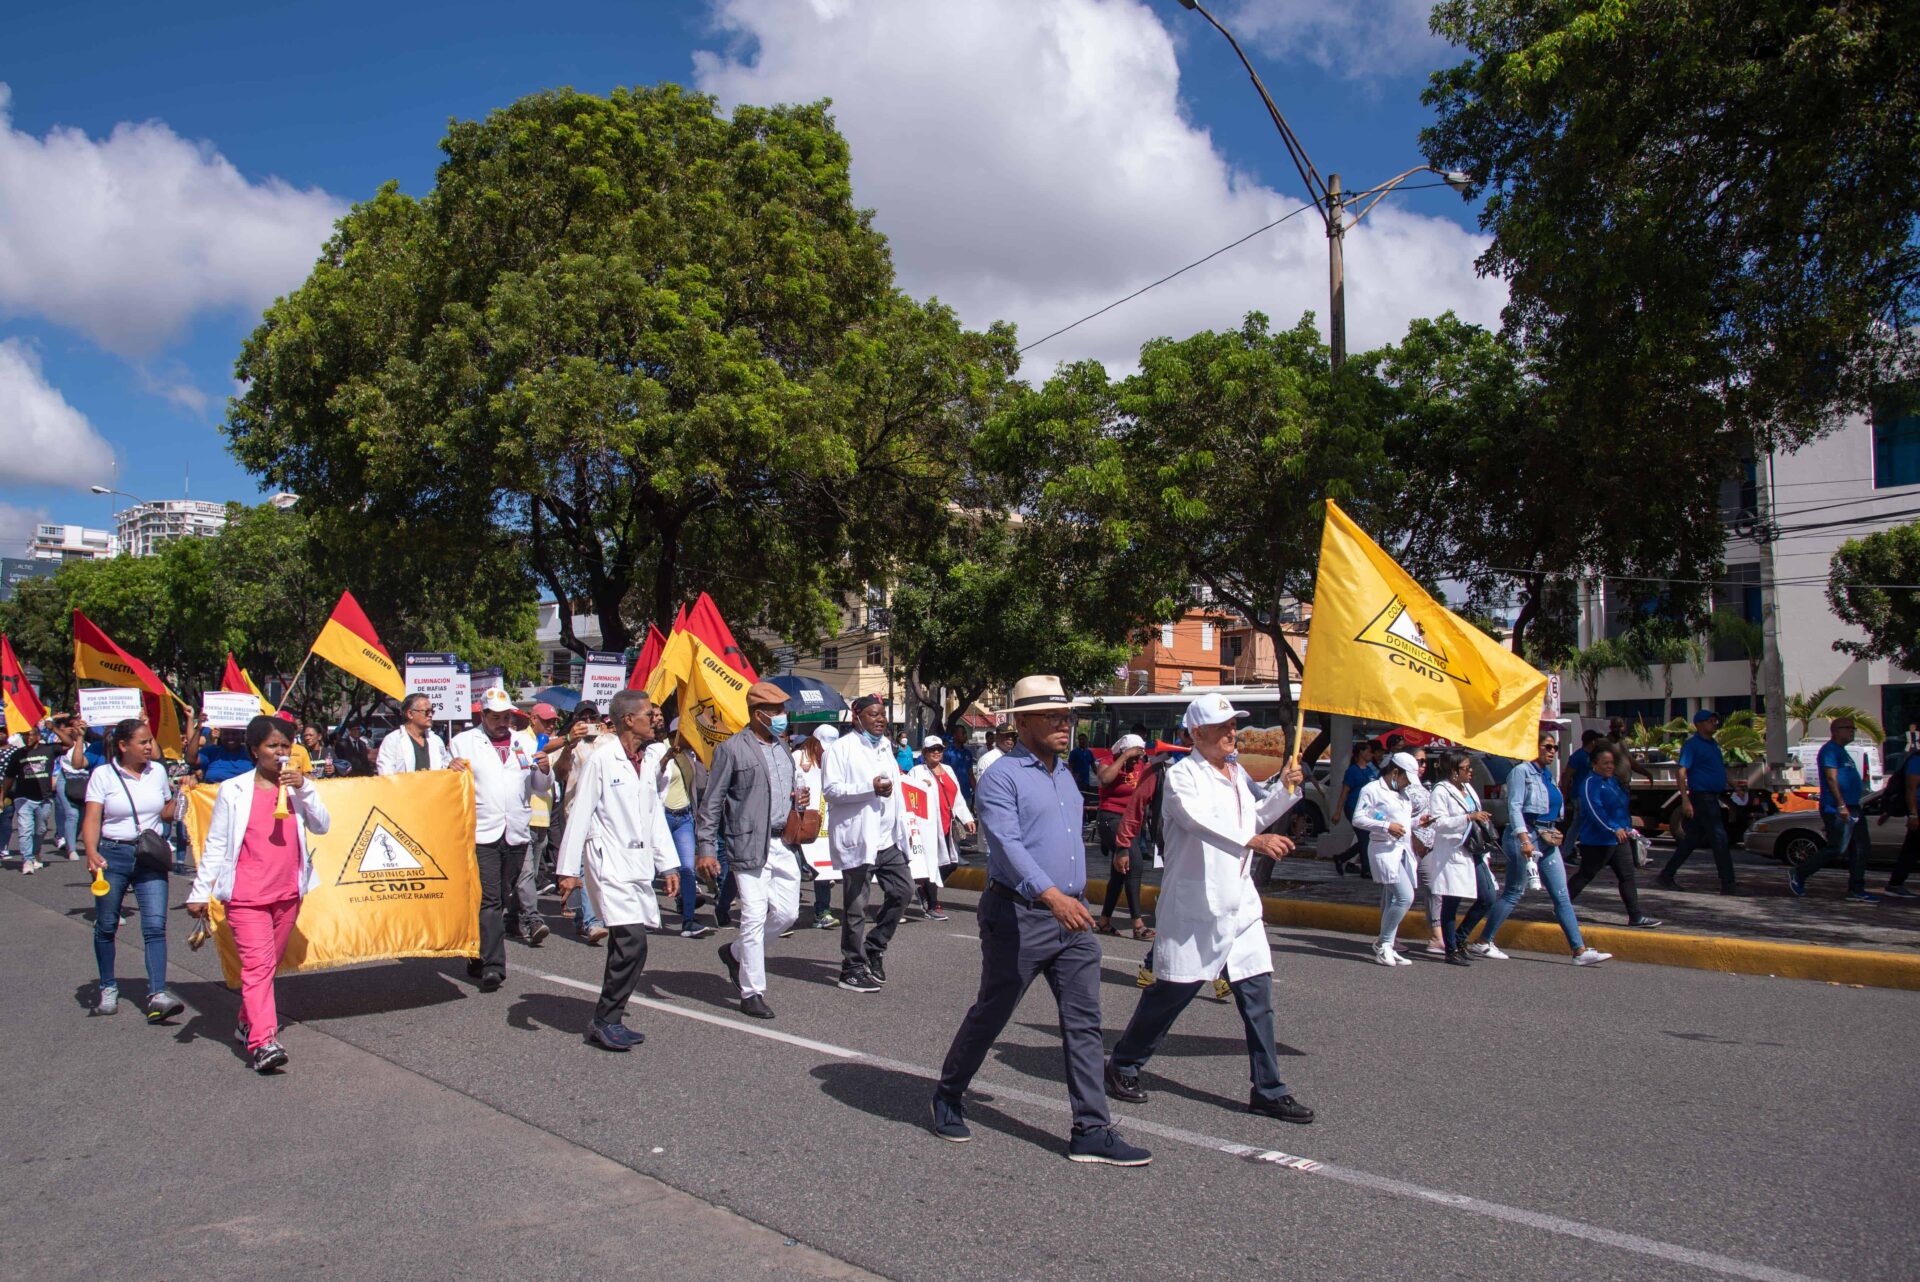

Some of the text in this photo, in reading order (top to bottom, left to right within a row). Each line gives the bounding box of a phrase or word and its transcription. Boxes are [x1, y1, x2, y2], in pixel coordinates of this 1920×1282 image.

[362, 648, 392, 670] COLECTIVO
[1386, 635, 1447, 670] DOMINICANO
[100, 660, 136, 675] COLECTIV
[703, 656, 744, 691] COLECTIVO
[1388, 653, 1444, 683] CMD
[431, 702, 444, 711] P'S
[353, 829, 372, 861] COLEGIO
[394, 830, 422, 856] MEDICO
[360, 869, 426, 879] DOMINICANO
[349, 895, 374, 904] FILIAL
[376, 892, 413, 901] SANCHEZ
[369, 881, 425, 893] CMD
